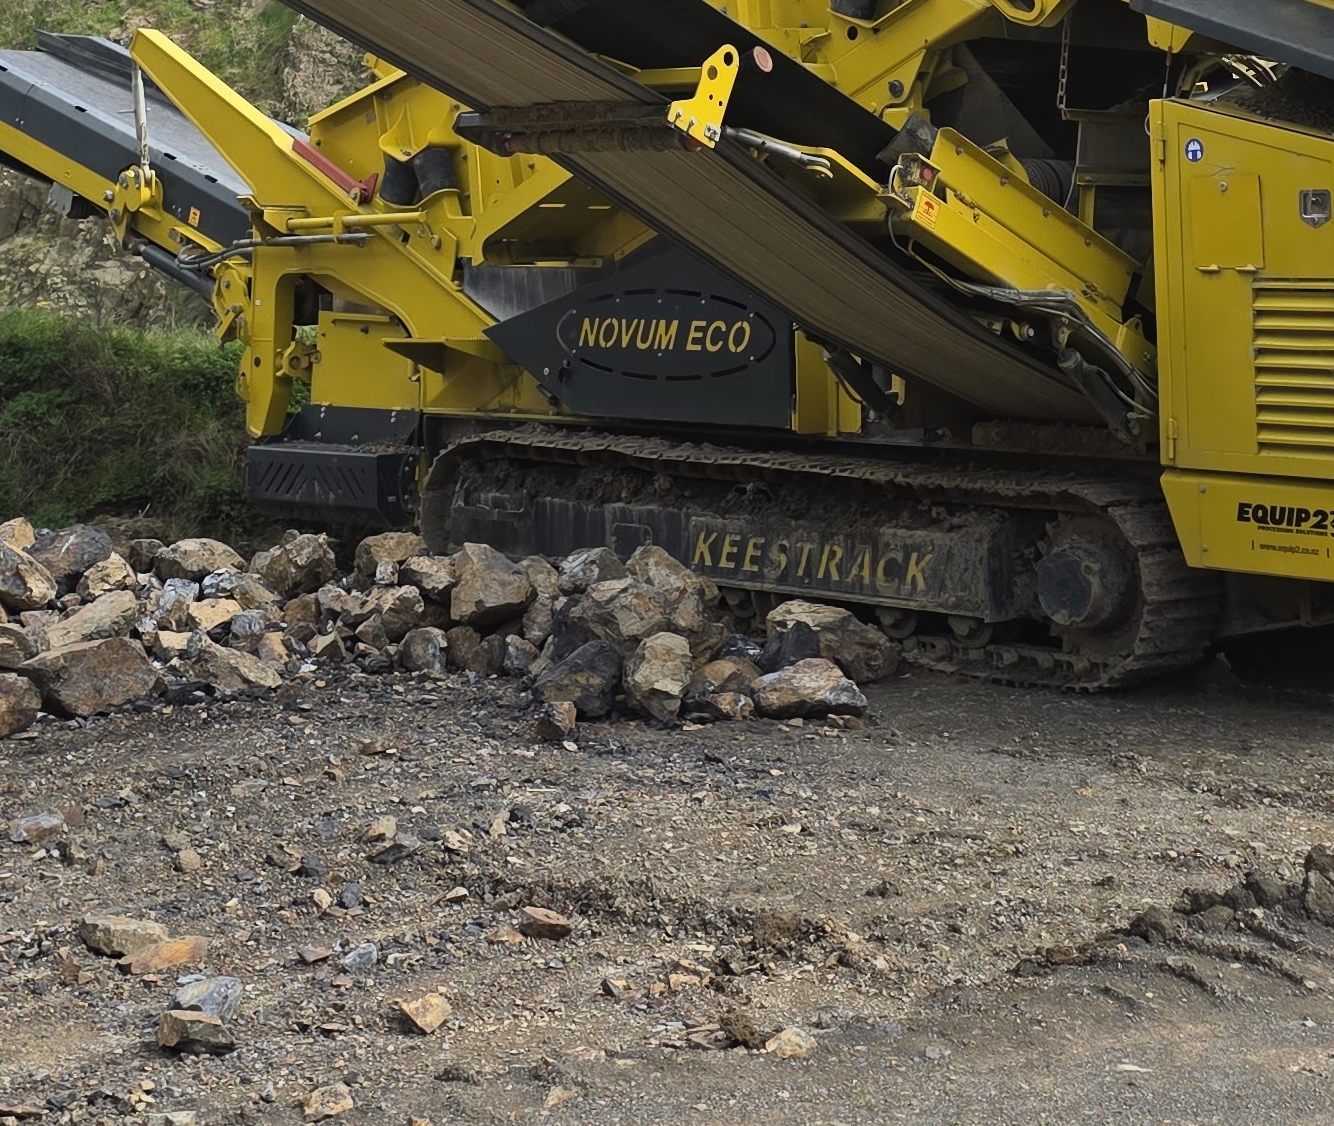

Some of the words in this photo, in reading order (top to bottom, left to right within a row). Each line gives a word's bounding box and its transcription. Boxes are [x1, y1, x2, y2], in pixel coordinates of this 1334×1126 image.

[578, 317, 678, 349] NOVUM
[685, 320, 751, 353] ECO
[1258, 525, 1294, 533] PROCESSING
[691, 530, 934, 590] KEESTRACK
[1260, 544, 1319, 555] www.equip2.co.nz
